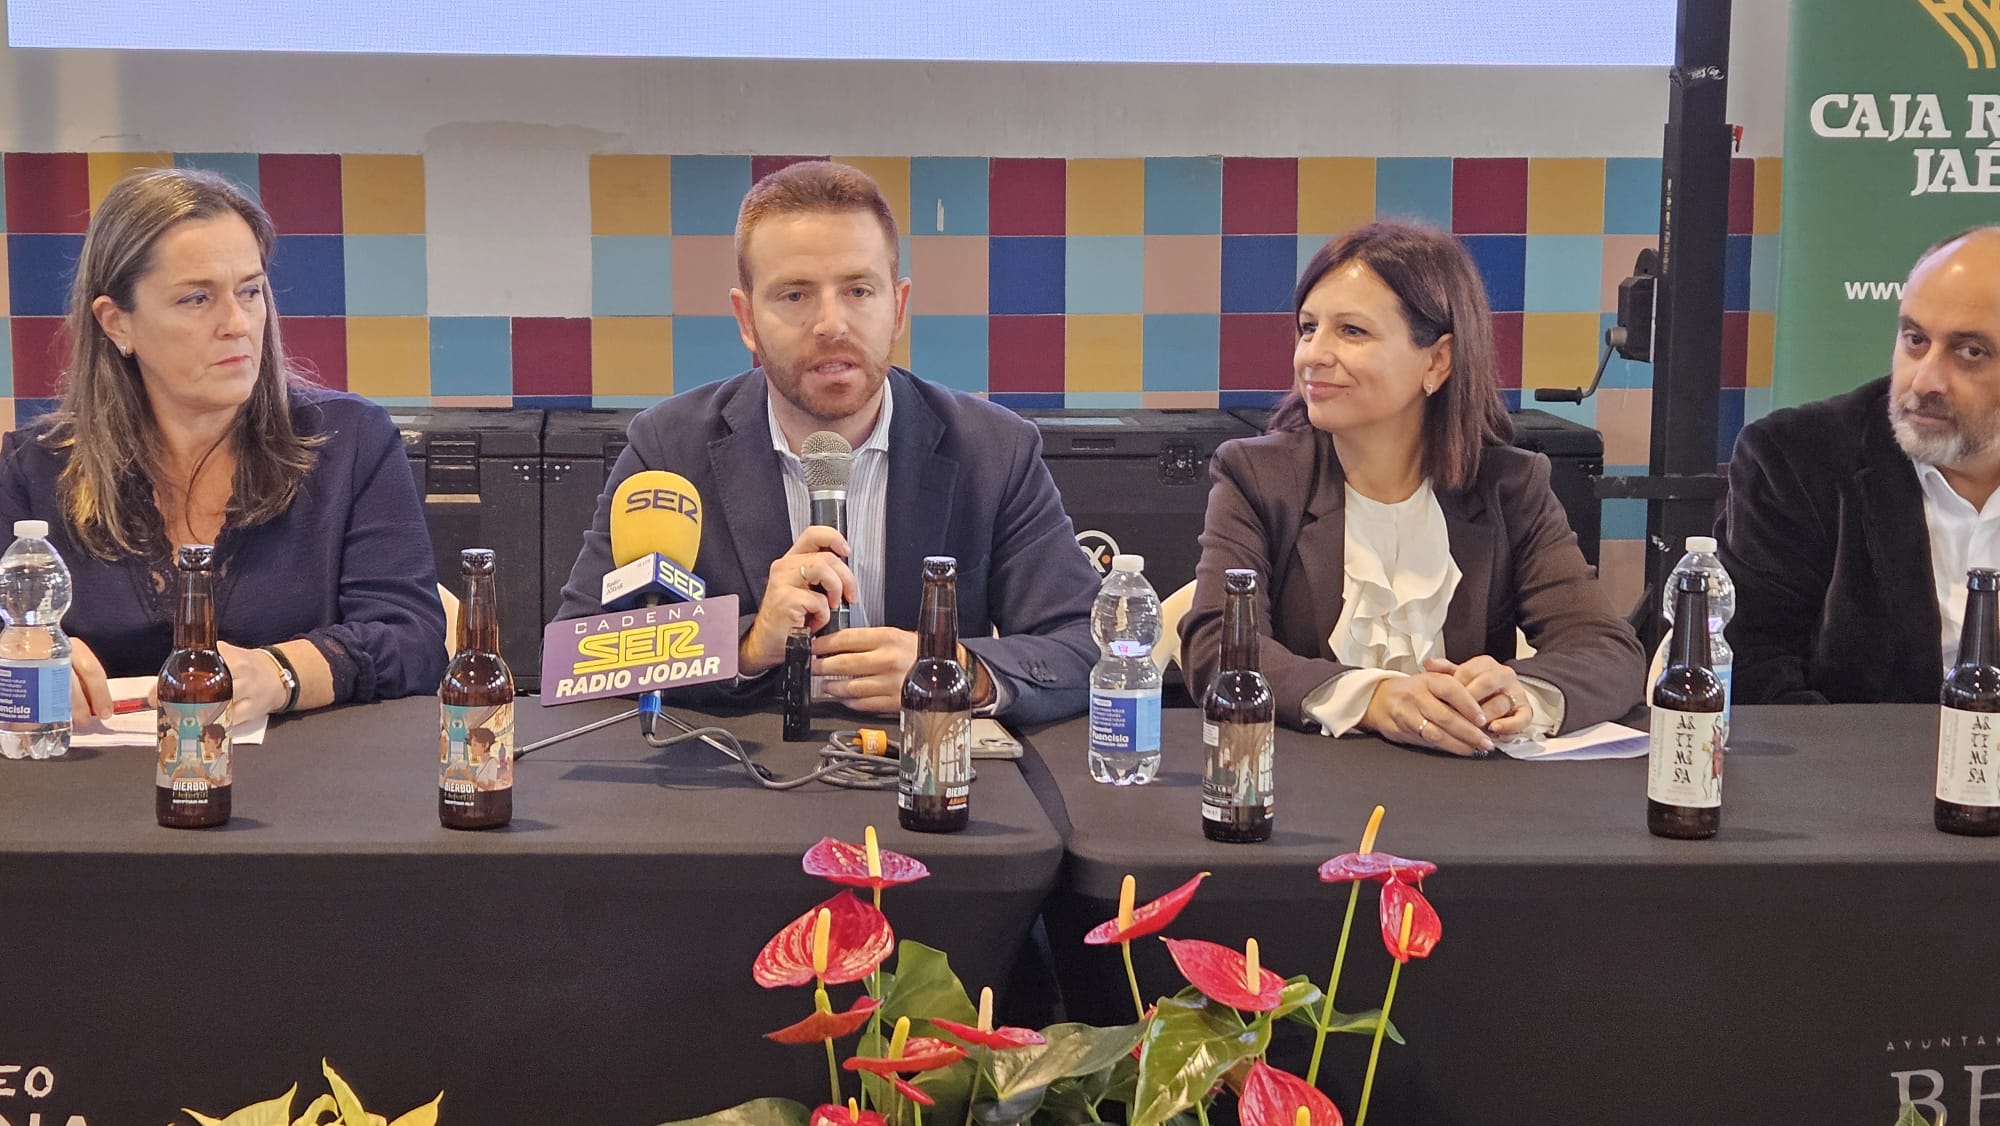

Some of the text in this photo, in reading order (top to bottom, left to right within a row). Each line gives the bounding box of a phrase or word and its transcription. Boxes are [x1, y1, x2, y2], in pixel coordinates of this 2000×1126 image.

[1810, 93, 2000, 142] CAJA R
[1911, 140, 2000, 196] JAÉ
[625, 488, 698, 525] SER
[659, 560, 705, 601] SER
[575, 604, 705, 635] CADENA
[573, 620, 705, 675] SER
[556, 656, 720, 698] RADIO JODAR
